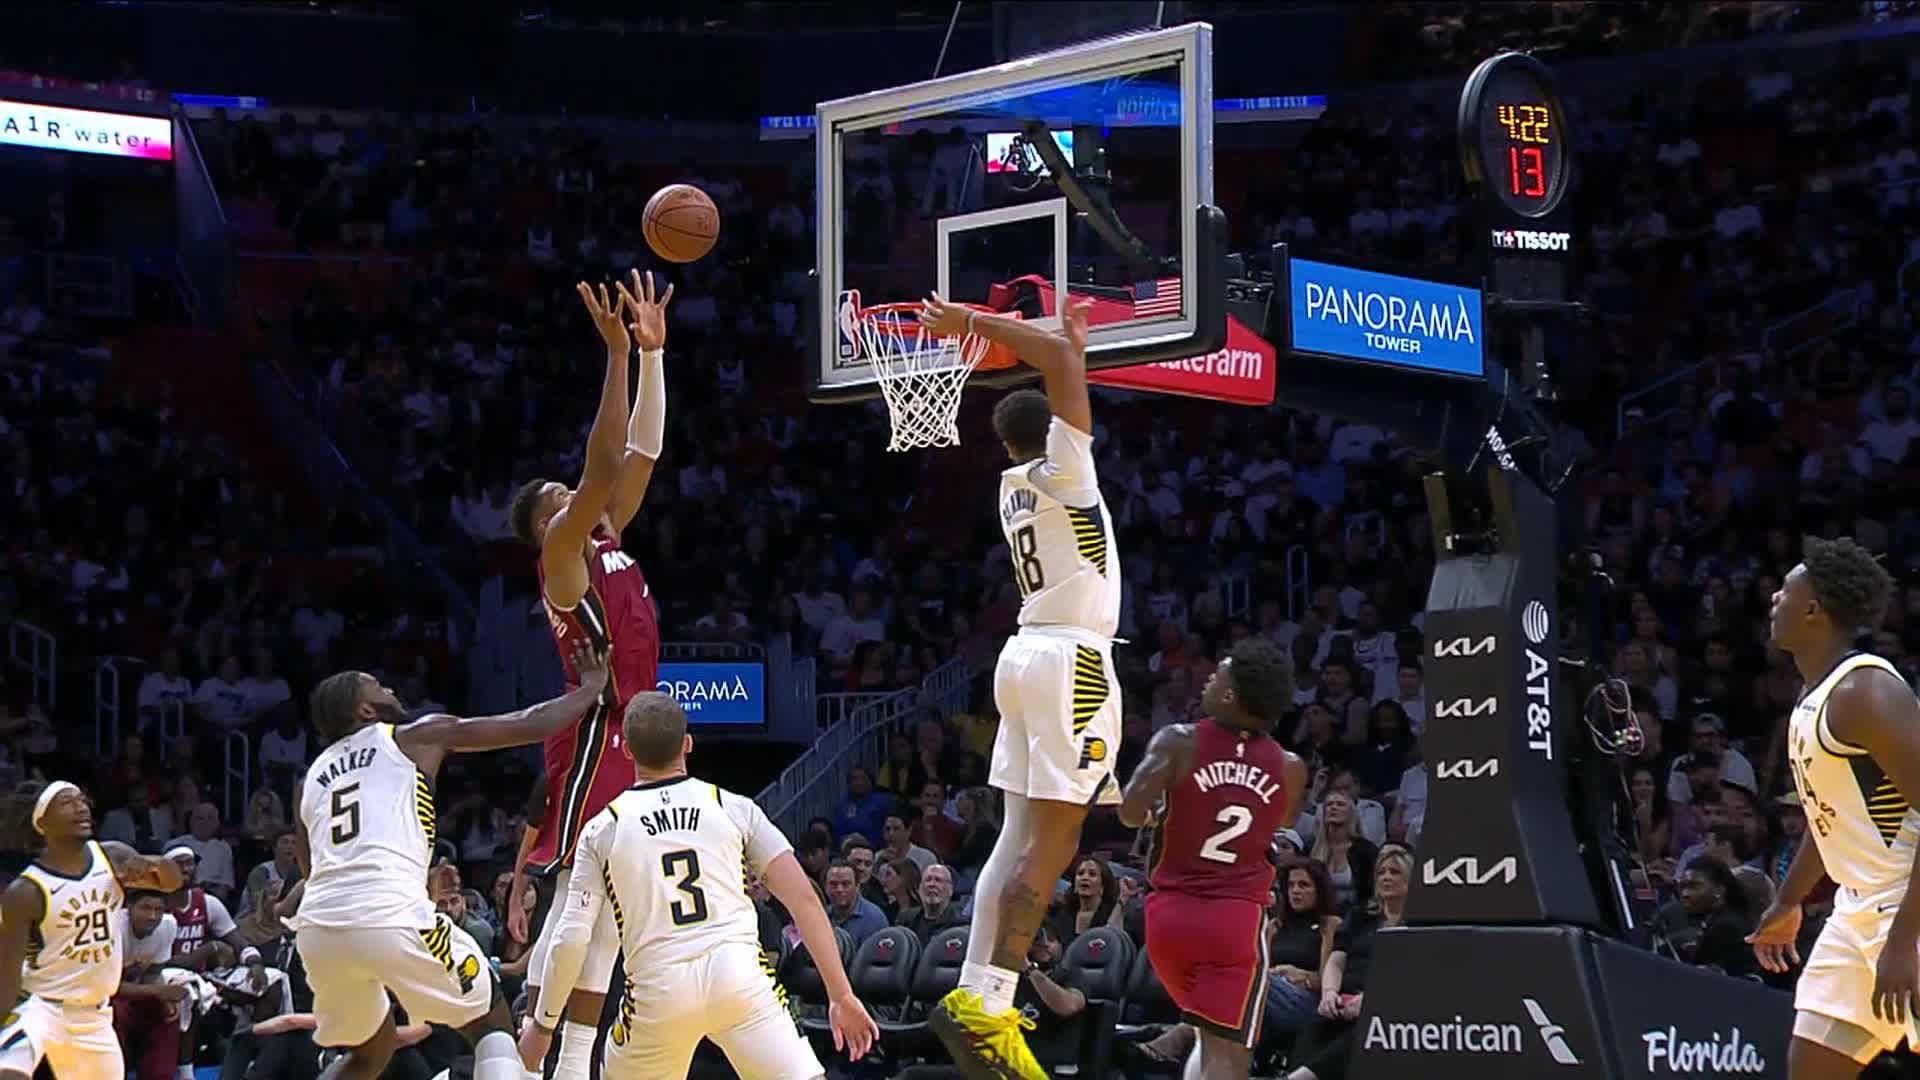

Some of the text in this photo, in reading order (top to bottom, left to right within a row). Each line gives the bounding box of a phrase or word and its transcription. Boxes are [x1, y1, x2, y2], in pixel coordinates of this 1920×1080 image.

[75, 128, 152, 149] water
[1499, 106, 1549, 143] 4:22
[1511, 147, 1545, 196] 13
[1514, 230, 1571, 250] TISSOT
[1364, 331, 1421, 354] TOWER
[656, 674, 749, 701] ORAMÀ
[1525, 648, 1553, 761] AT&T
[316, 747, 377, 788] WALKER
[1193, 761, 1280, 804] MITCHELL
[330, 781, 361, 846] 5
[640, 807, 700, 836] SMITH
[1200, 805, 1253, 863] 2
[661, 848, 708, 926] 3
[74, 908, 110, 947] 29
[1364, 1015, 1522, 1053] American
[1641, 1026, 1766, 1073] Florida
